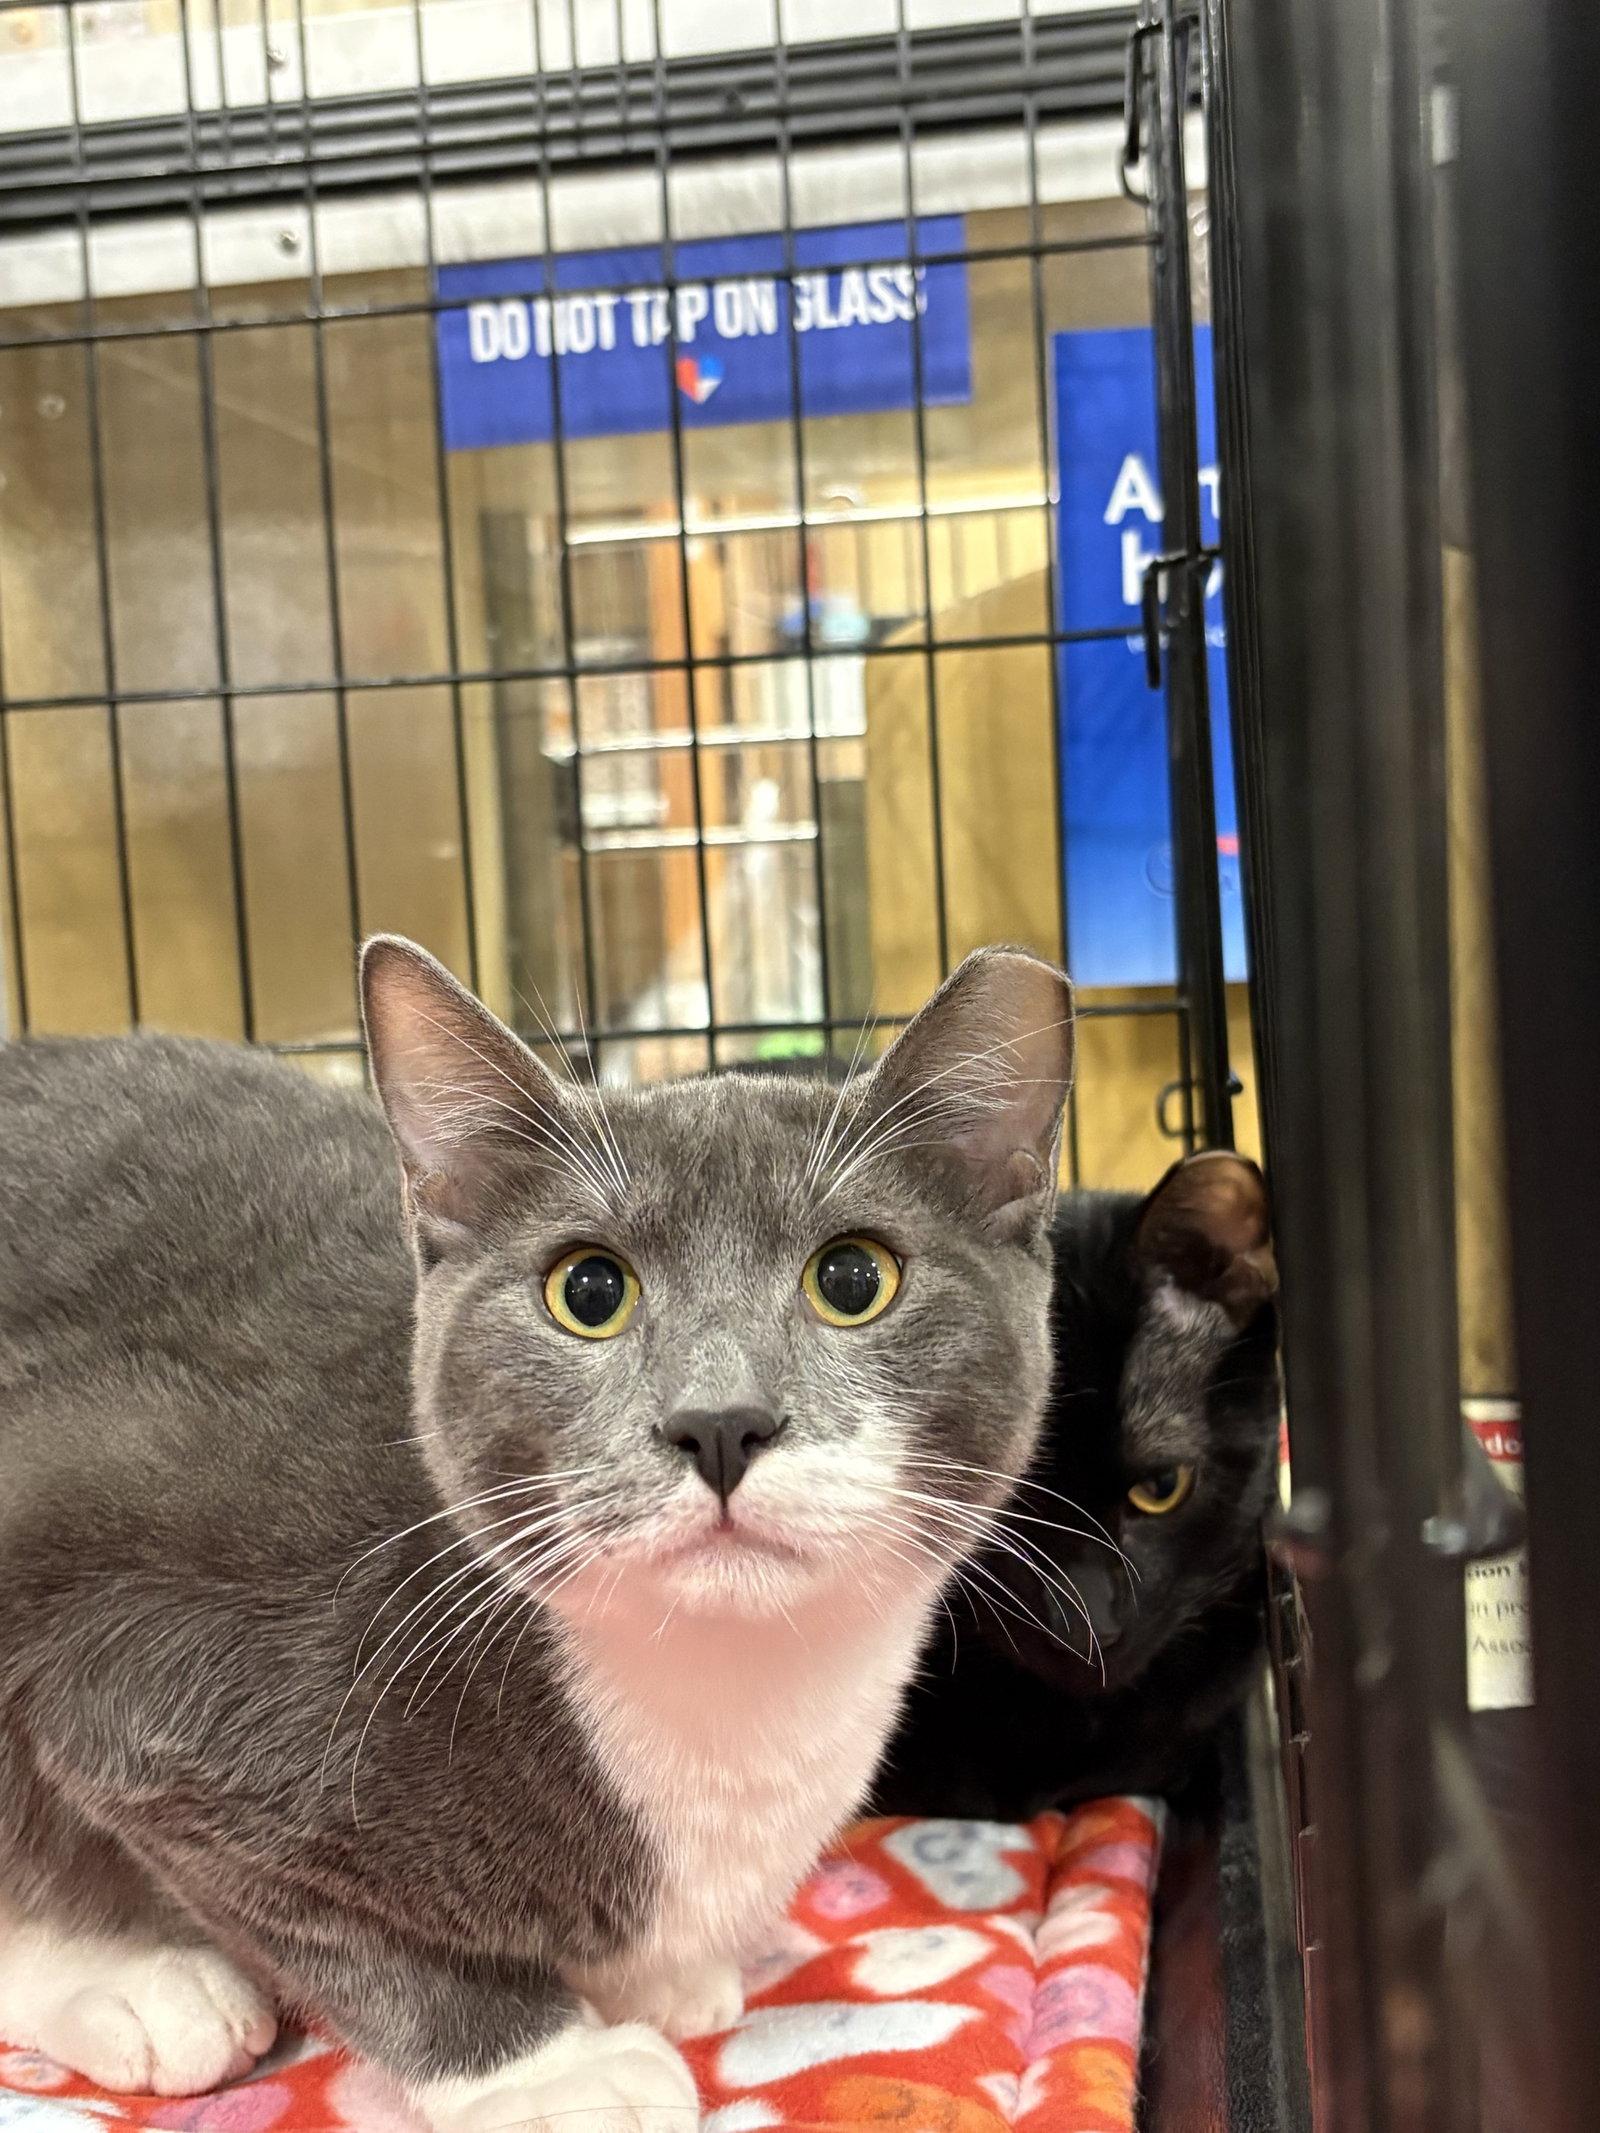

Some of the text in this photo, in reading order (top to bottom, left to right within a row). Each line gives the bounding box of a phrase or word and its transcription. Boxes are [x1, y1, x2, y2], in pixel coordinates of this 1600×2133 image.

[468, 264, 928, 363] DO NOT TAP ON GLASS
